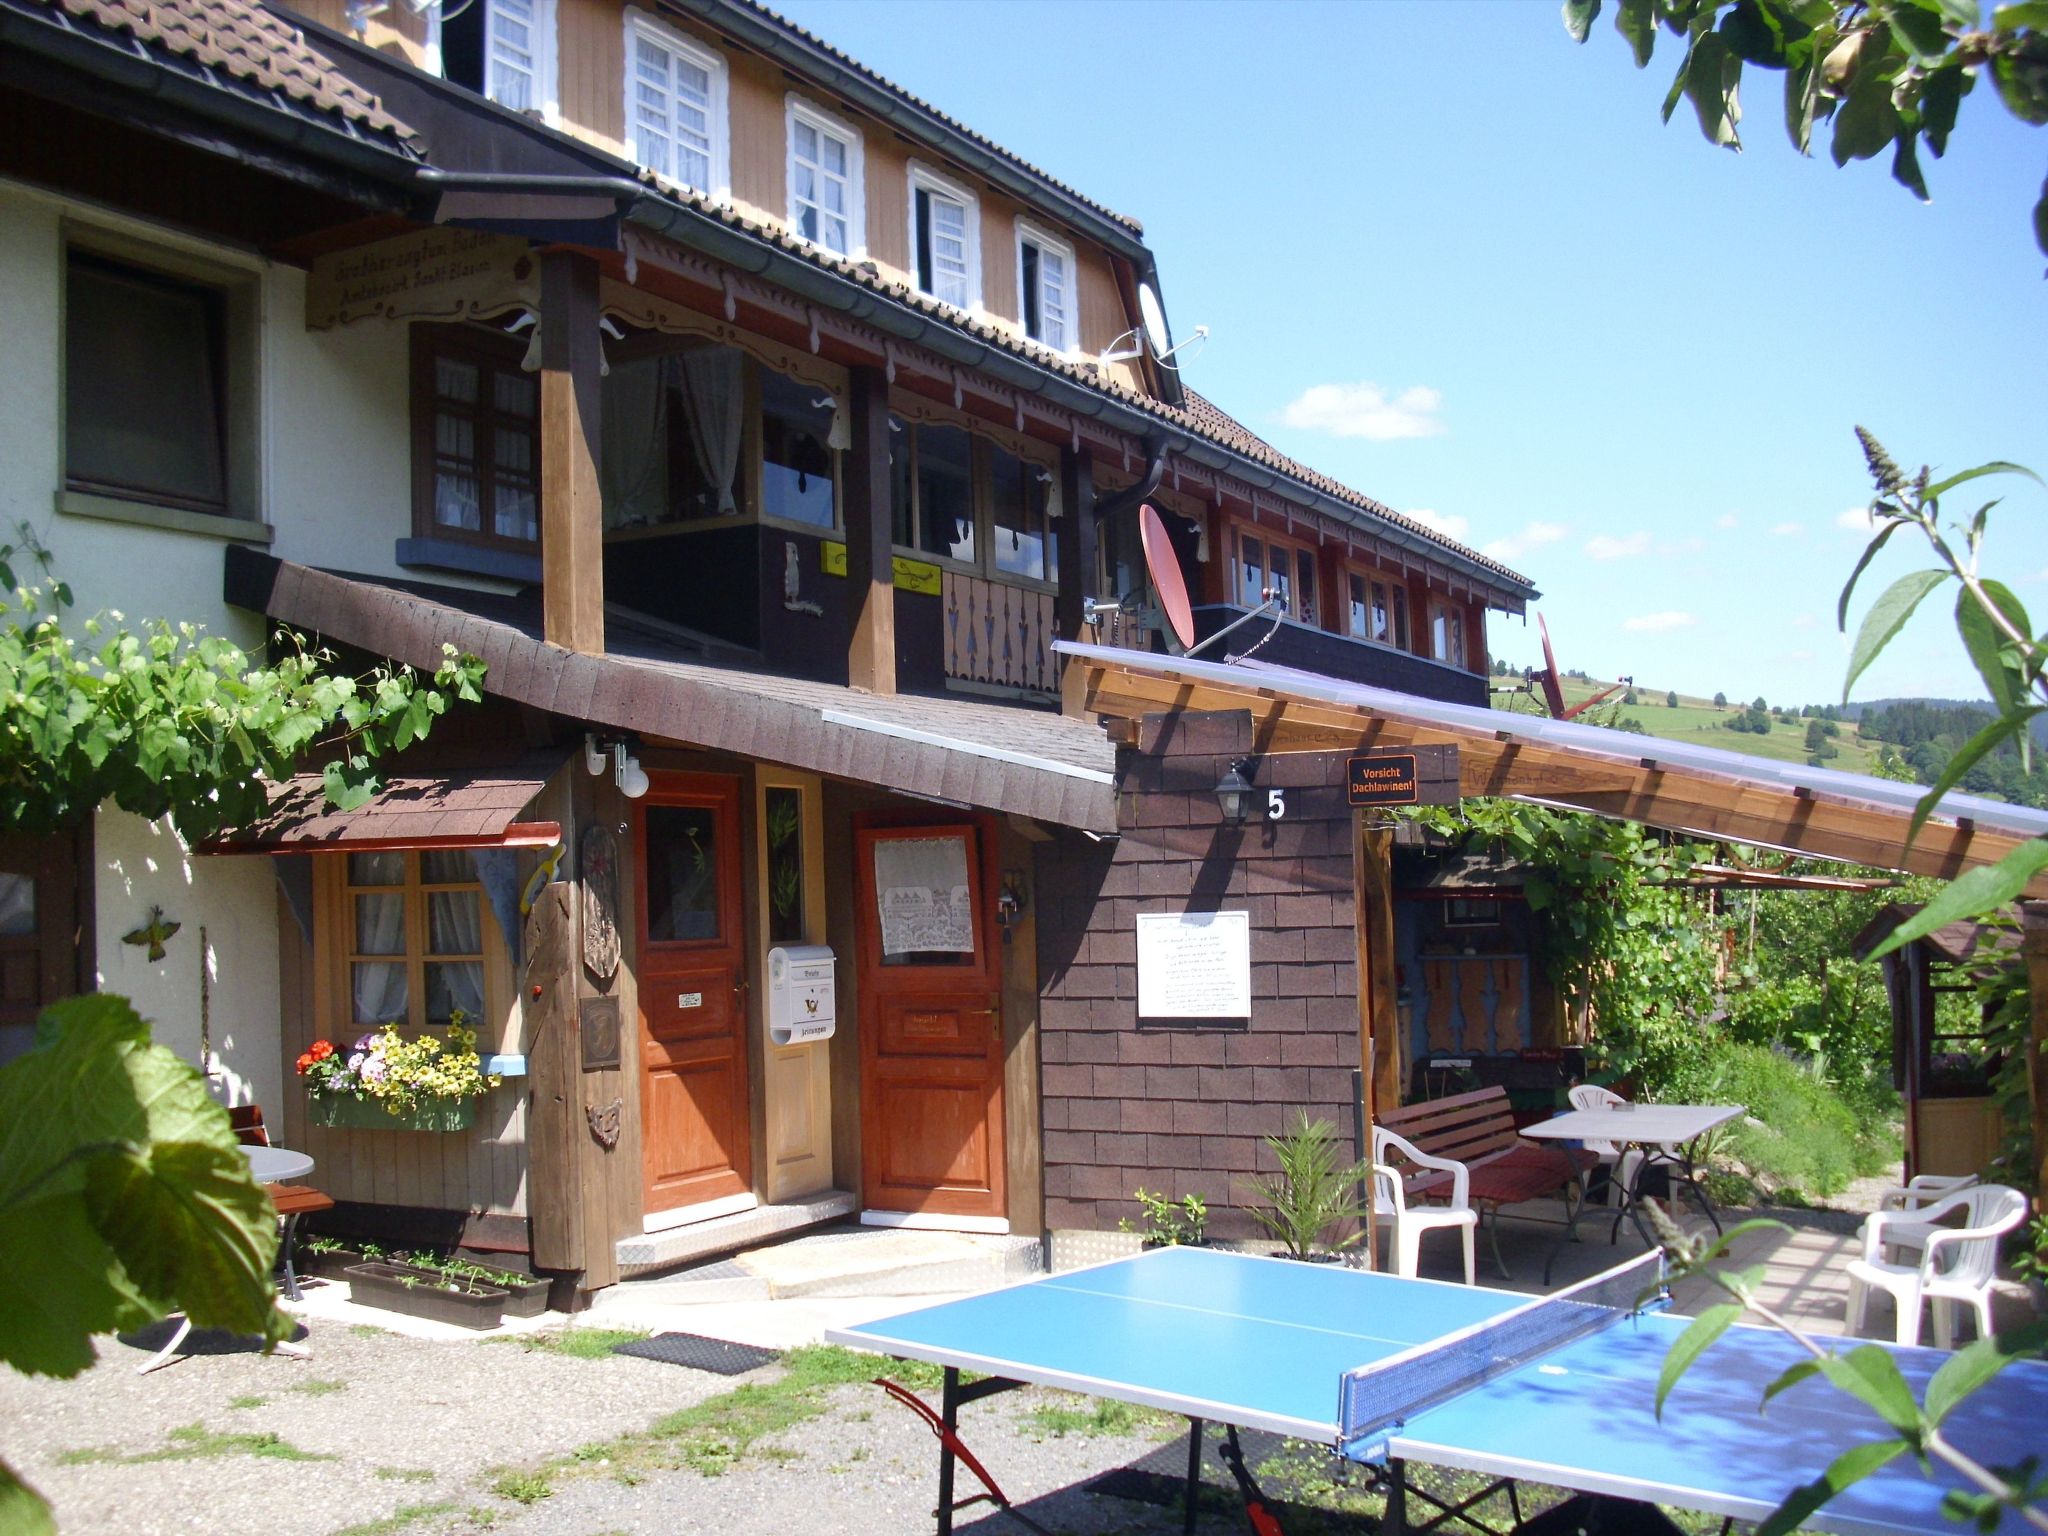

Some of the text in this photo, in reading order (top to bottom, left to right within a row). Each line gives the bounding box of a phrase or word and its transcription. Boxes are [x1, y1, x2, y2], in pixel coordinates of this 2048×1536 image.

[1363, 767, 1401, 779] Vorsicht
[1352, 780, 1413, 793] Dachlawinen!
[1268, 789, 1285, 820] 5
